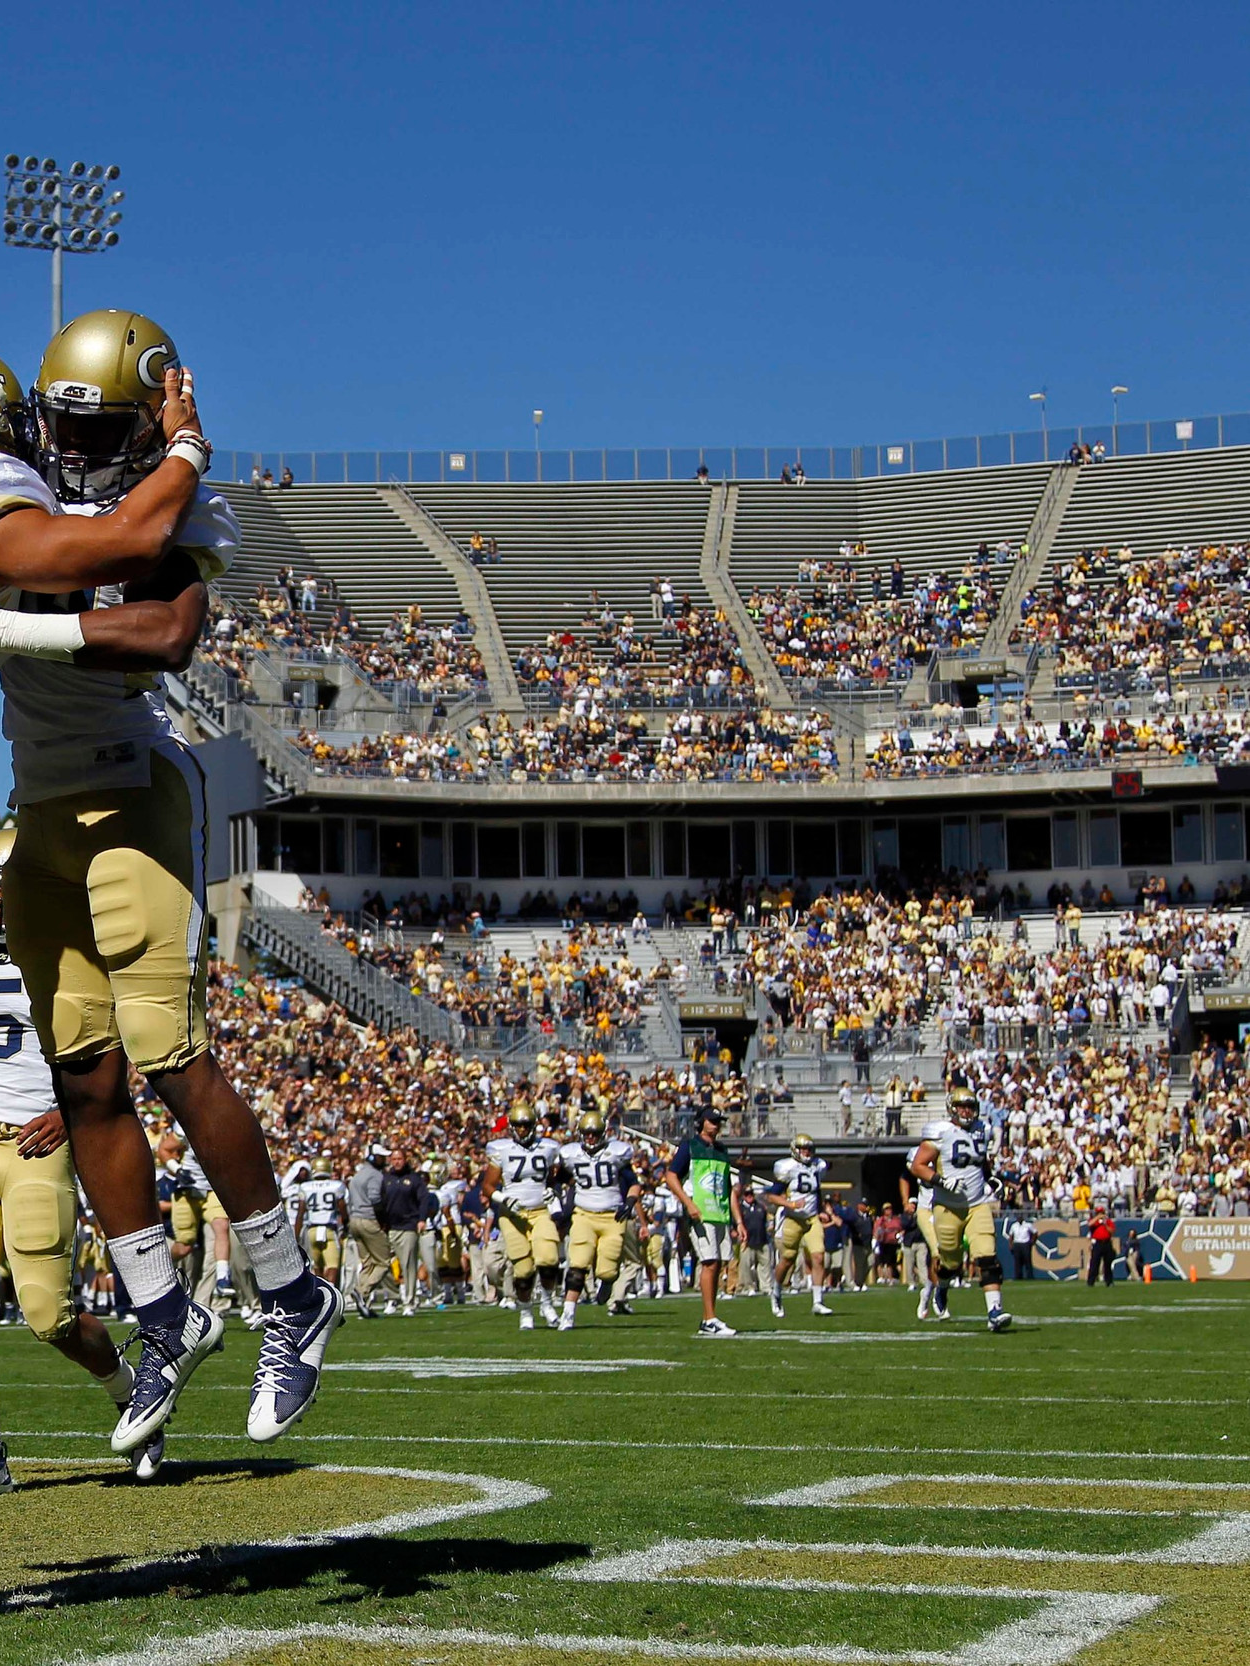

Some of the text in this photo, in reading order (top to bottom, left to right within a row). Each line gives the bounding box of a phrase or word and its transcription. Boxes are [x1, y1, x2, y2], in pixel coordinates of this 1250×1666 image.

[1115, 772, 1140, 796] 25
[508, 1154, 548, 1183] 79
[573, 1161, 615, 1190] 50
[306, 1191, 336, 1212] 49
[1183, 1224, 1250, 1237] FOLLOW U
[181, 1304, 205, 1357] NIKE
